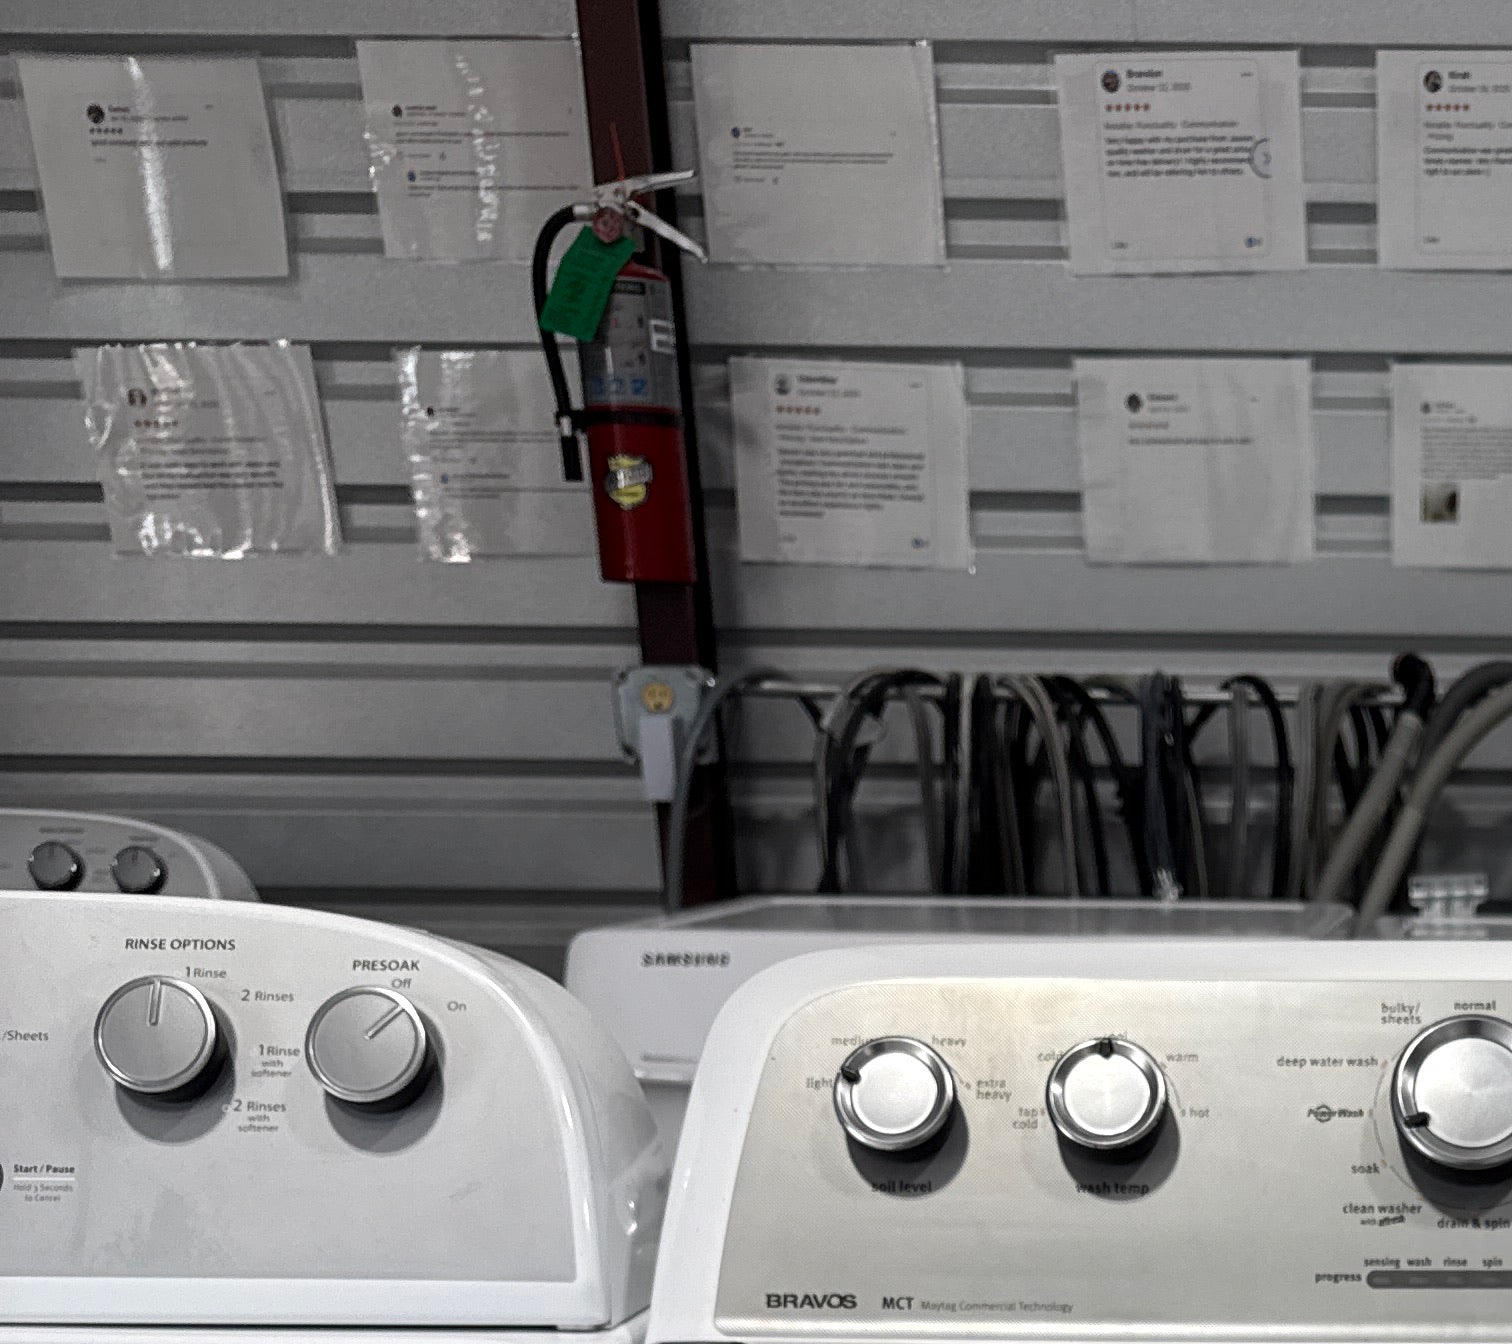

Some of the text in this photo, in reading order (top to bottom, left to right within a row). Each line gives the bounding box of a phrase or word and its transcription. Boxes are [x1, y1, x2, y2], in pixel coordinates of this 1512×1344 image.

[125, 938, 236, 951] RINSE OPTIONS
[352, 959, 420, 971] PRESOAK
[641, 951, 730, 967] SAMSUNG
[185, 966, 227, 978] 1 Rinse
[391, 978, 412, 989] Off
[241, 989, 294, 1002] 2 Rinses
[447, 1000, 467, 1012] On
[1453, 1001, 1496, 1011] normal
[1381, 1015, 1422, 1025] sheets
[259, 1044, 301, 1056] 1 Rinse
[1277, 1056, 1378, 1069] deep water wash
[233, 1100, 287, 1112] 2 Rinses
[13, 1164, 38, 1174] Start
[45, 1164, 75, 1174] Pause
[1351, 1163, 1380, 1174] soak
[872, 1180, 932, 1192] soil level
[1076, 1182, 1149, 1195] wash temp
[1343, 1203, 1422, 1214] clean washer
[1437, 1217, 1469, 1229] drain
[1485, 1218, 1511, 1231] spin
[1407, 1257, 1432, 1267] wash
[1443, 1257, 1468, 1267] rinse
[1482, 1257, 1502, 1269] spin
[1315, 1273, 1362, 1284] progress
[766, 1294, 857, 1309] BRAVOS
[882, 1296, 914, 1310] MCT
